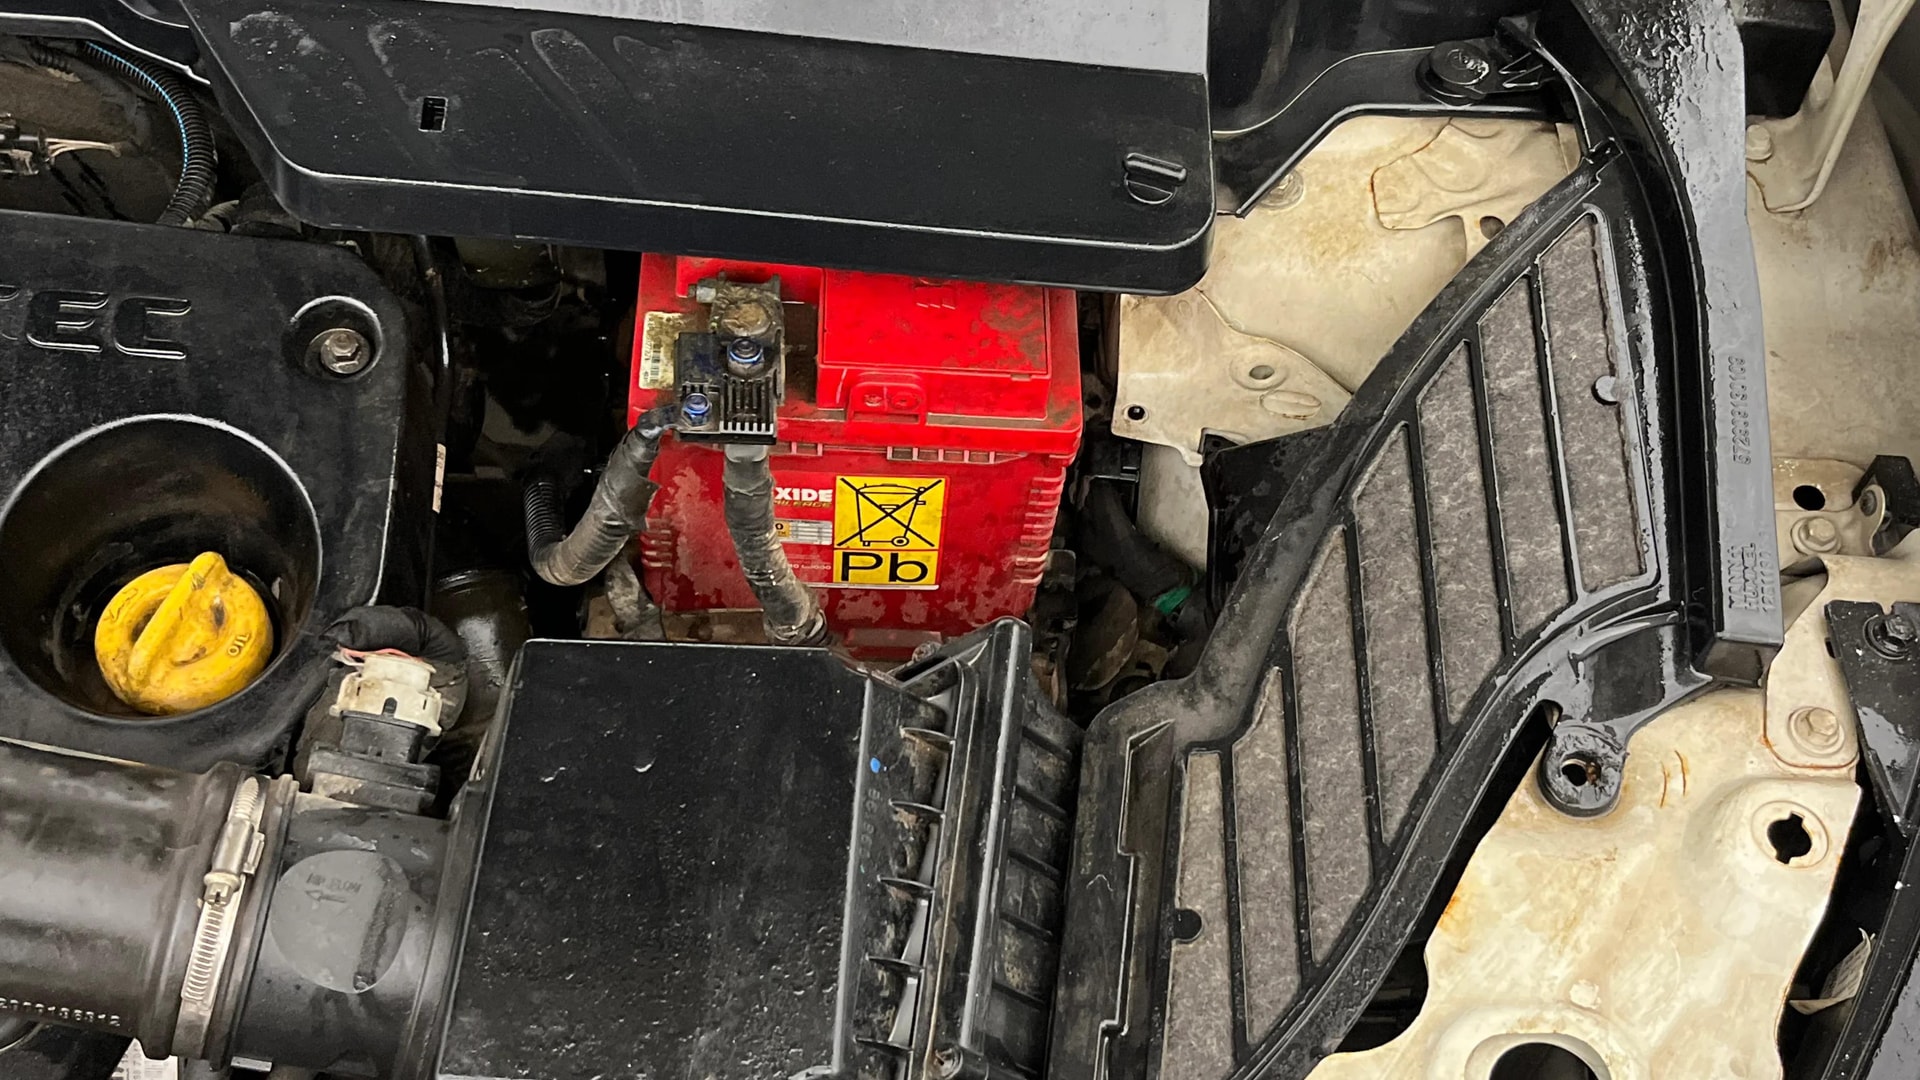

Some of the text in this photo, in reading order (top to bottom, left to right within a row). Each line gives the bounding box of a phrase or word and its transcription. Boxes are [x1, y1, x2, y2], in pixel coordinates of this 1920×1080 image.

[0, 284, 191, 359] EC
[774, 487, 833, 502] XIDE
[841, 551, 929, 583] Pb
[1741, 542, 1759, 612] HUMMEL
[227, 633, 250, 657] OIL
